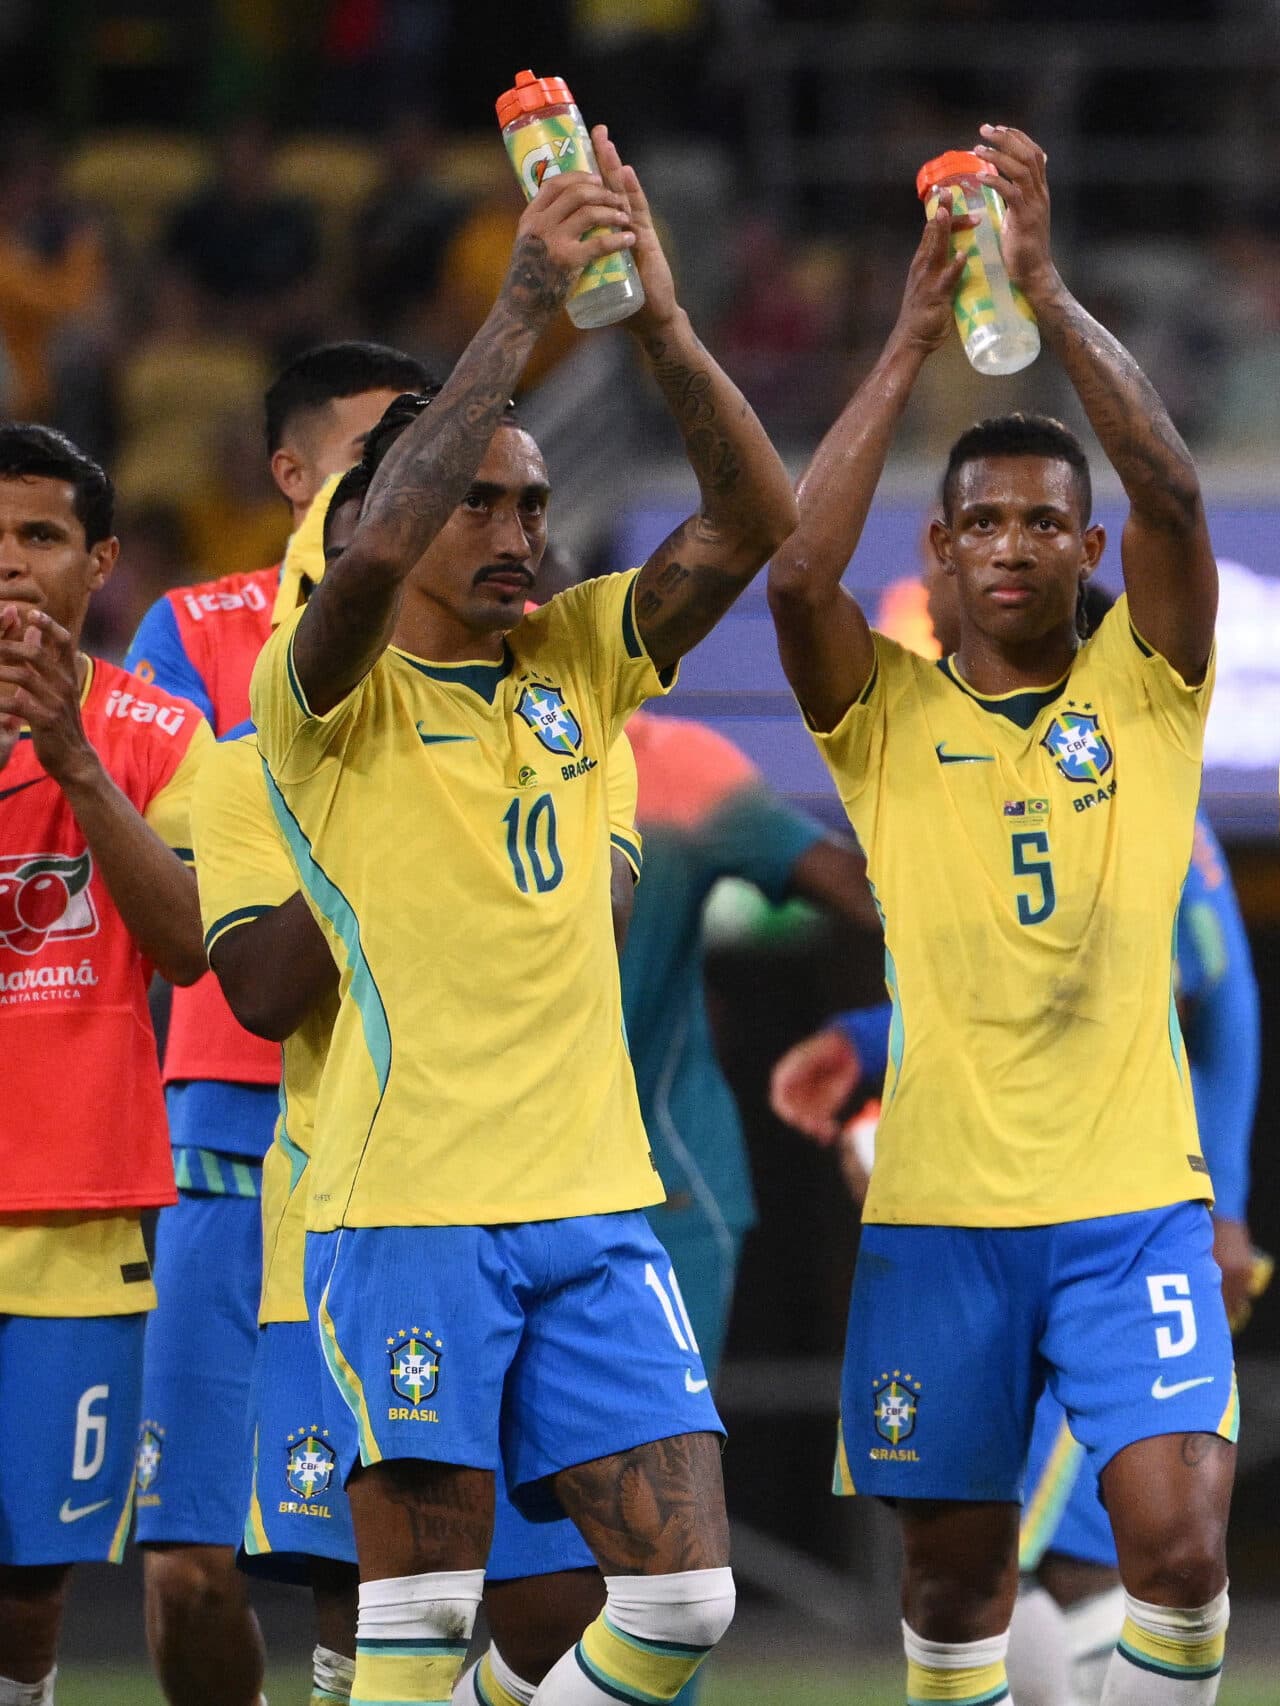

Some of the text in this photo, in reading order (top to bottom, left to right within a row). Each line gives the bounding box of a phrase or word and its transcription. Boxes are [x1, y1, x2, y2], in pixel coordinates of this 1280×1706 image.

[106, 690, 185, 736] itaú
[540, 712, 557, 726] CBF
[1066, 738, 1088, 753] CBF
[502, 793, 564, 893] 10
[1011, 831, 1056, 925] 5
[1, 989, 81, 1004] ANTARCTICA
[1146, 1273, 1197, 1359] 5
[405, 1366, 424, 1374] CBF
[389, 1407, 439, 1423] BRASIL
[886, 1407, 904, 1415] CBF
[72, 1384, 109, 1480] 6
[870, 1448, 920, 1462] BRASIL
[301, 1462, 319, 1470] CBF
[279, 1501, 332, 1518] BRASIL
